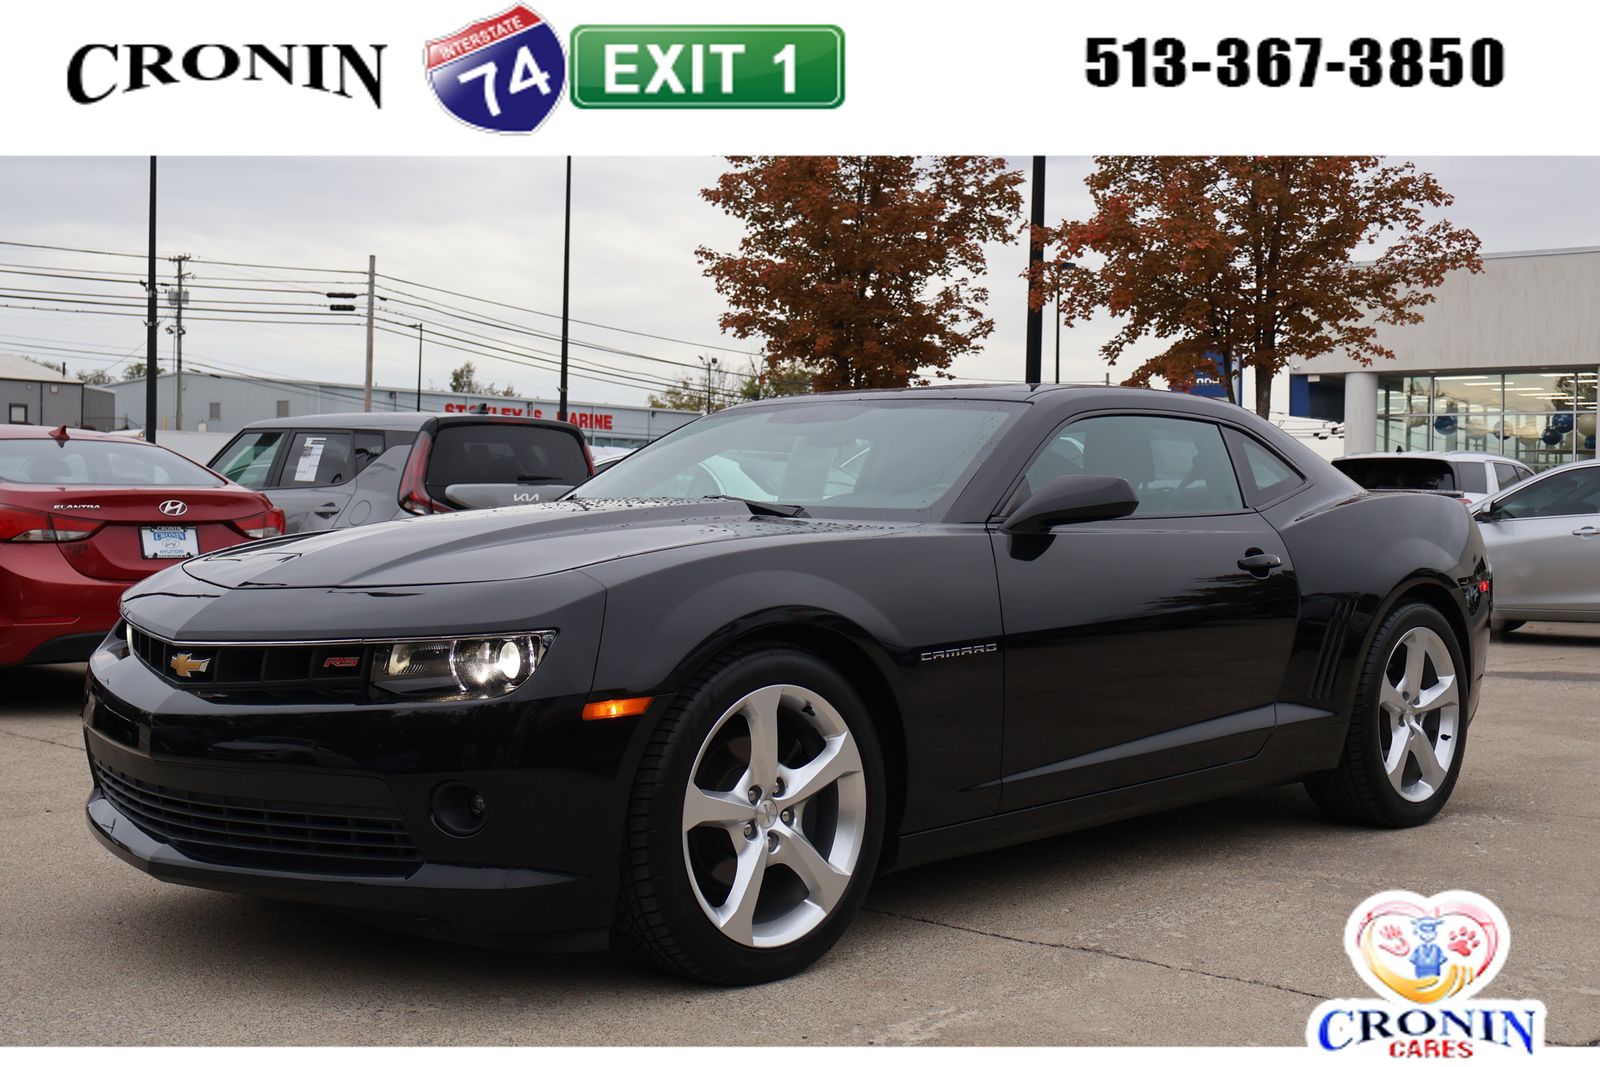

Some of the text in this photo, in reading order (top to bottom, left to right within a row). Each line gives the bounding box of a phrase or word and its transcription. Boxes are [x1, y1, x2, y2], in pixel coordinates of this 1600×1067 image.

[556, 411, 613, 430] ARINE
[154, 531, 186, 540] CRONIN
[920, 643, 997, 662] CAMARO
[323, 656, 360, 668] RS
